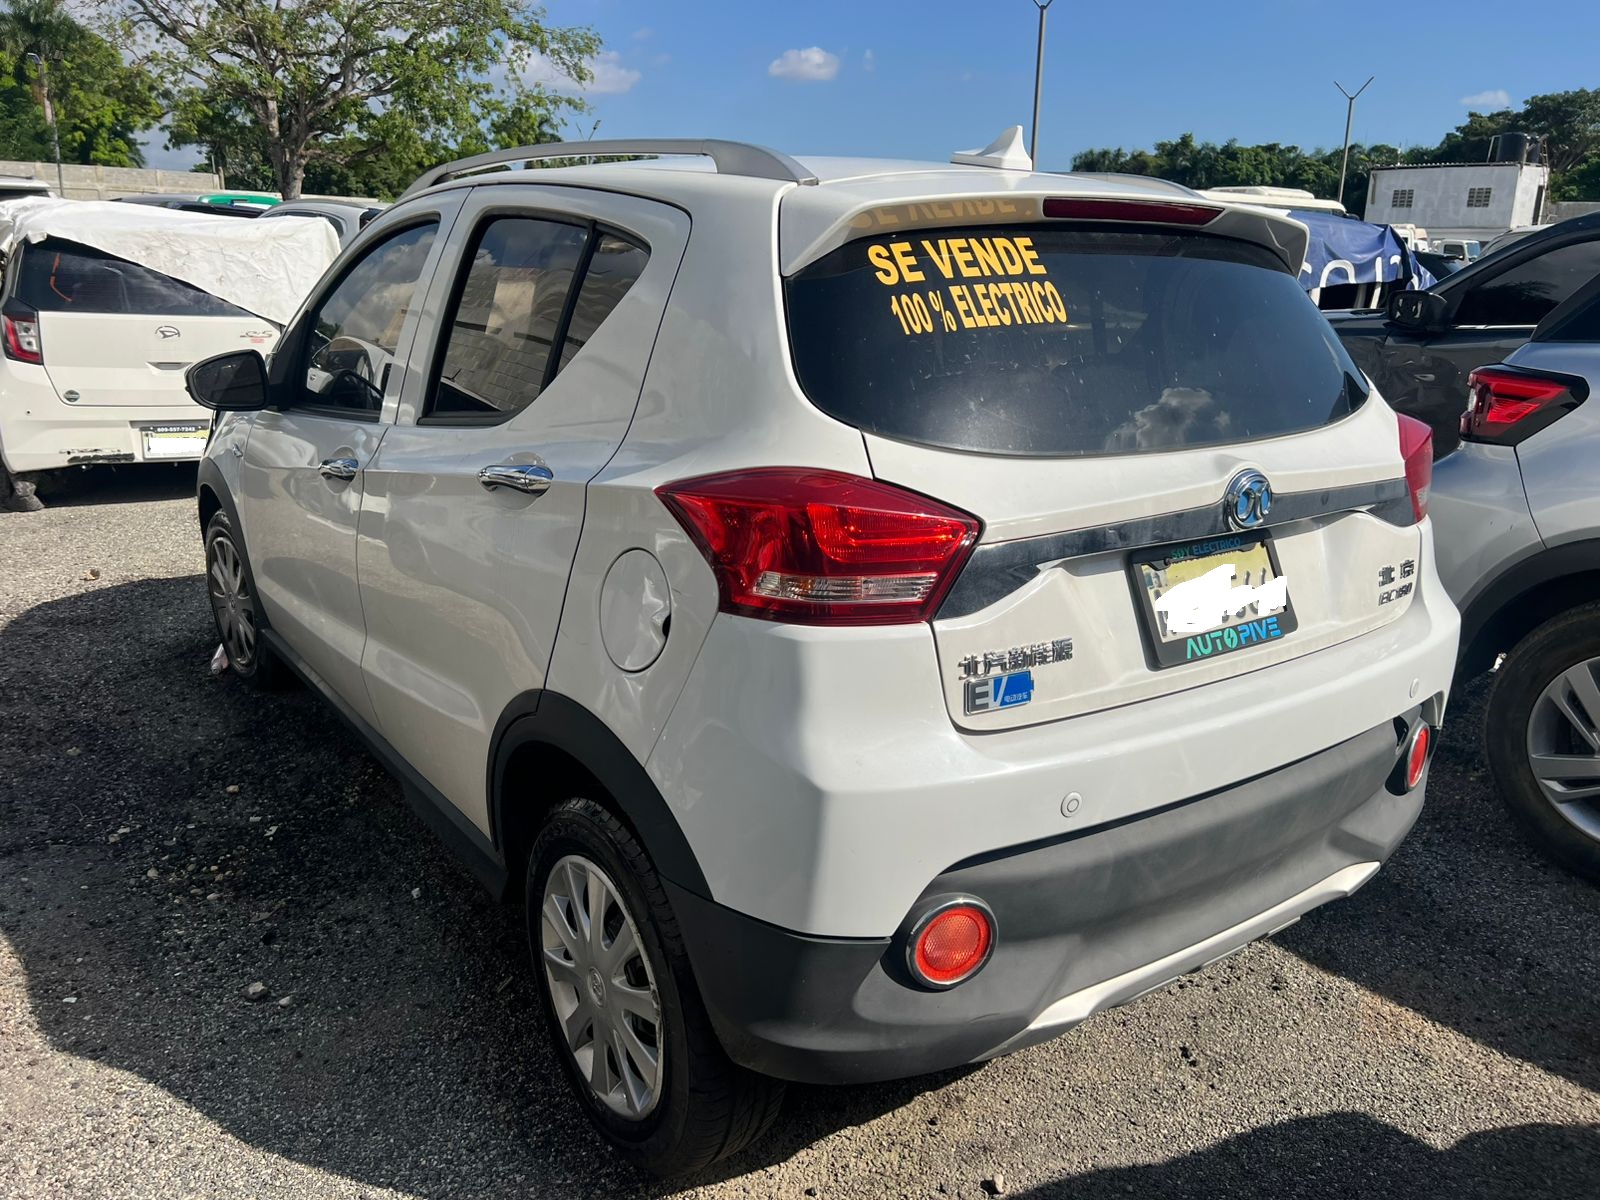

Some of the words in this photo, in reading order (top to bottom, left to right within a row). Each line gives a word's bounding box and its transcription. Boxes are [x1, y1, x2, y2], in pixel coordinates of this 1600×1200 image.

[867, 241, 926, 286] SE
[921, 237, 1047, 279] VENDE
[890, 292, 934, 335] 100
[948, 280, 1067, 329] ELECTRICO
[1192, 536, 1241, 556] ELECTRICO
